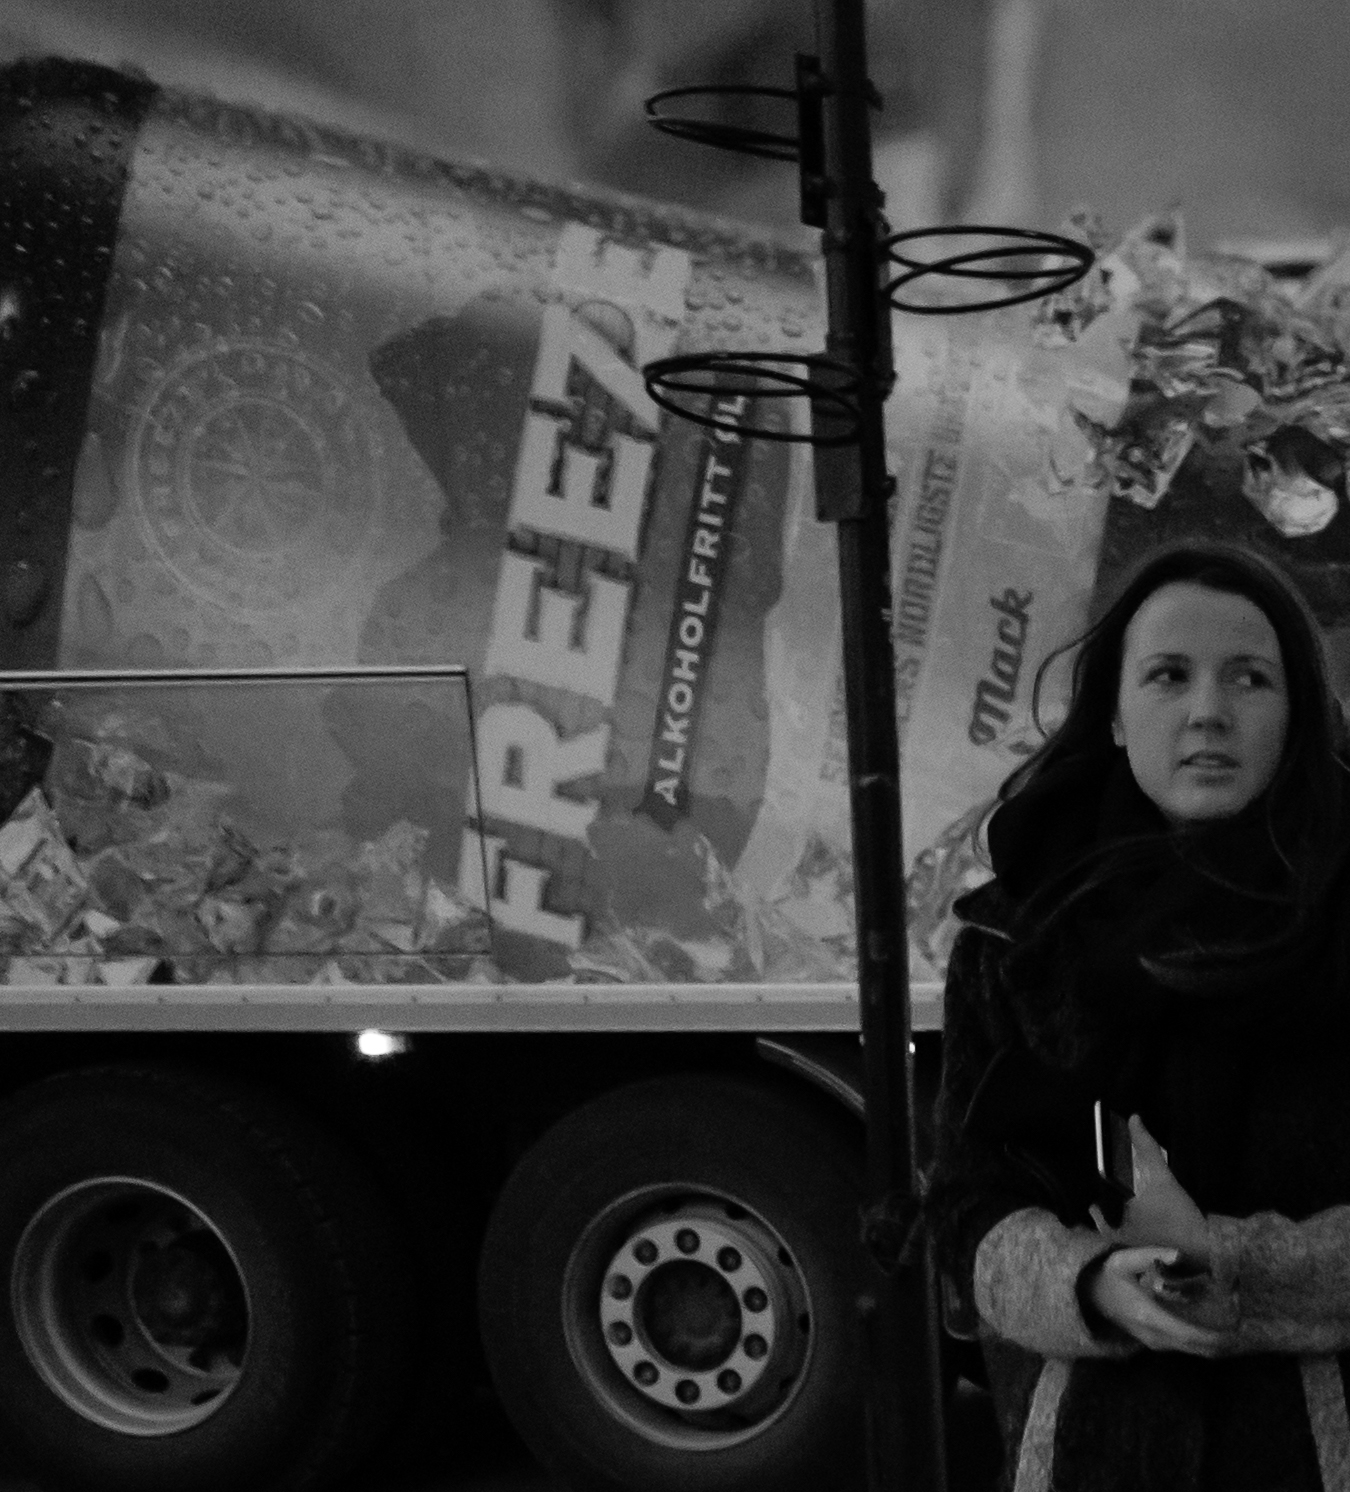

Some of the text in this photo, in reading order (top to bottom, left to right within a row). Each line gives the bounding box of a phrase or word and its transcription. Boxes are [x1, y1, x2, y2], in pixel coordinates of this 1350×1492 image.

[457, 221, 692, 947] FREEZE
[654, 455, 734, 806] ALKOHOLFRITT
[967, 587, 1033, 748] Mack
